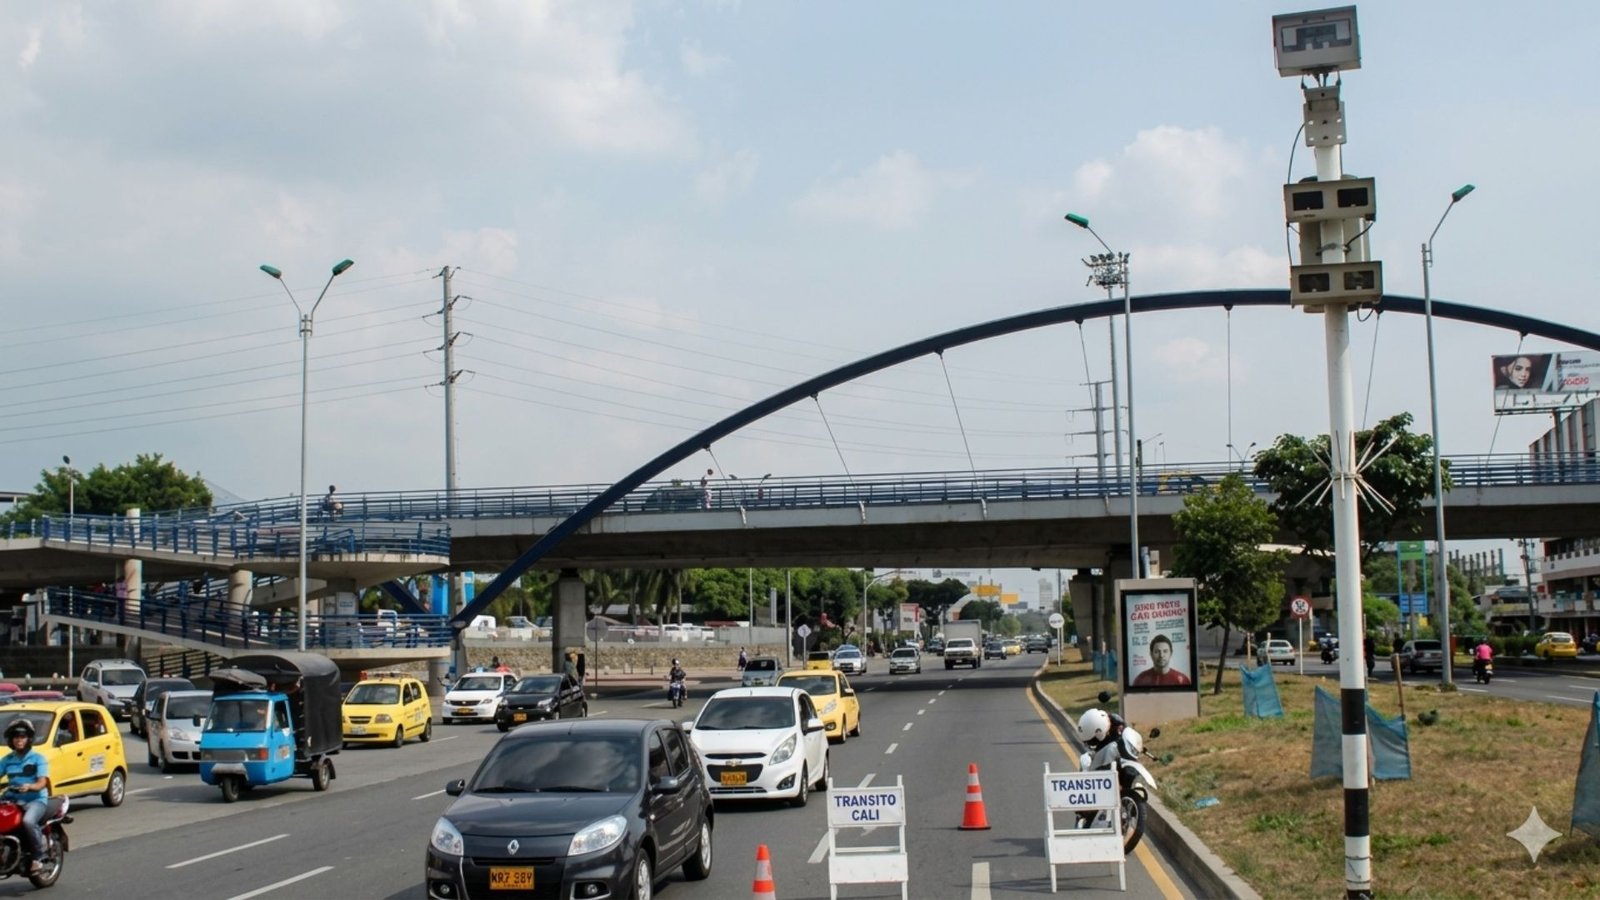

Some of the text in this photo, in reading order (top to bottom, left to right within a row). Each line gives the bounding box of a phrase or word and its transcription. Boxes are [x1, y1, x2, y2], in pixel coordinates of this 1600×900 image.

[1051, 778, 1112, 791] TRANSITO
[834, 794, 896, 807] TRANSITO
[1068, 793, 1096, 805] CALI
[851, 809, 879, 821] CALI
